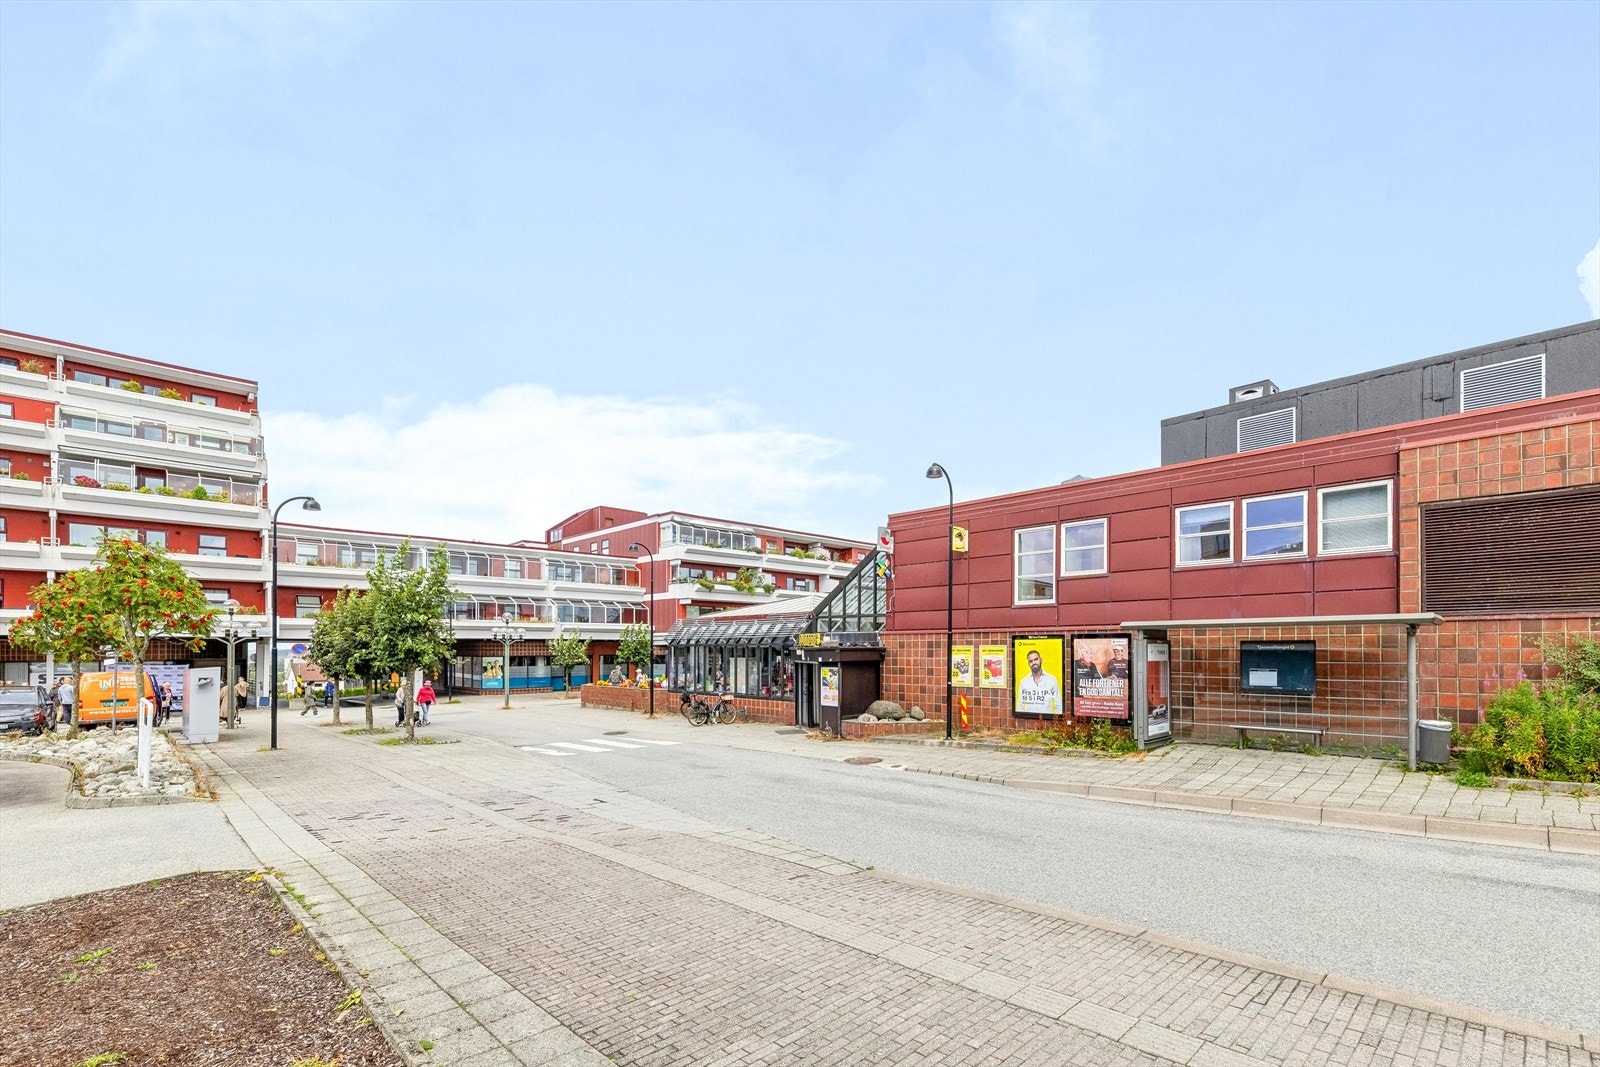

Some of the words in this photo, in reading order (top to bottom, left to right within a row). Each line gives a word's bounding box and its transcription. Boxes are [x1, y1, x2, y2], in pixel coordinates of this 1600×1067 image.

[1079, 678, 1092, 687] ALLE
[1080, 687, 1086, 696] EN
[1087, 688, 1098, 696] GOD
[1099, 688, 1124, 697] SAMTALE
